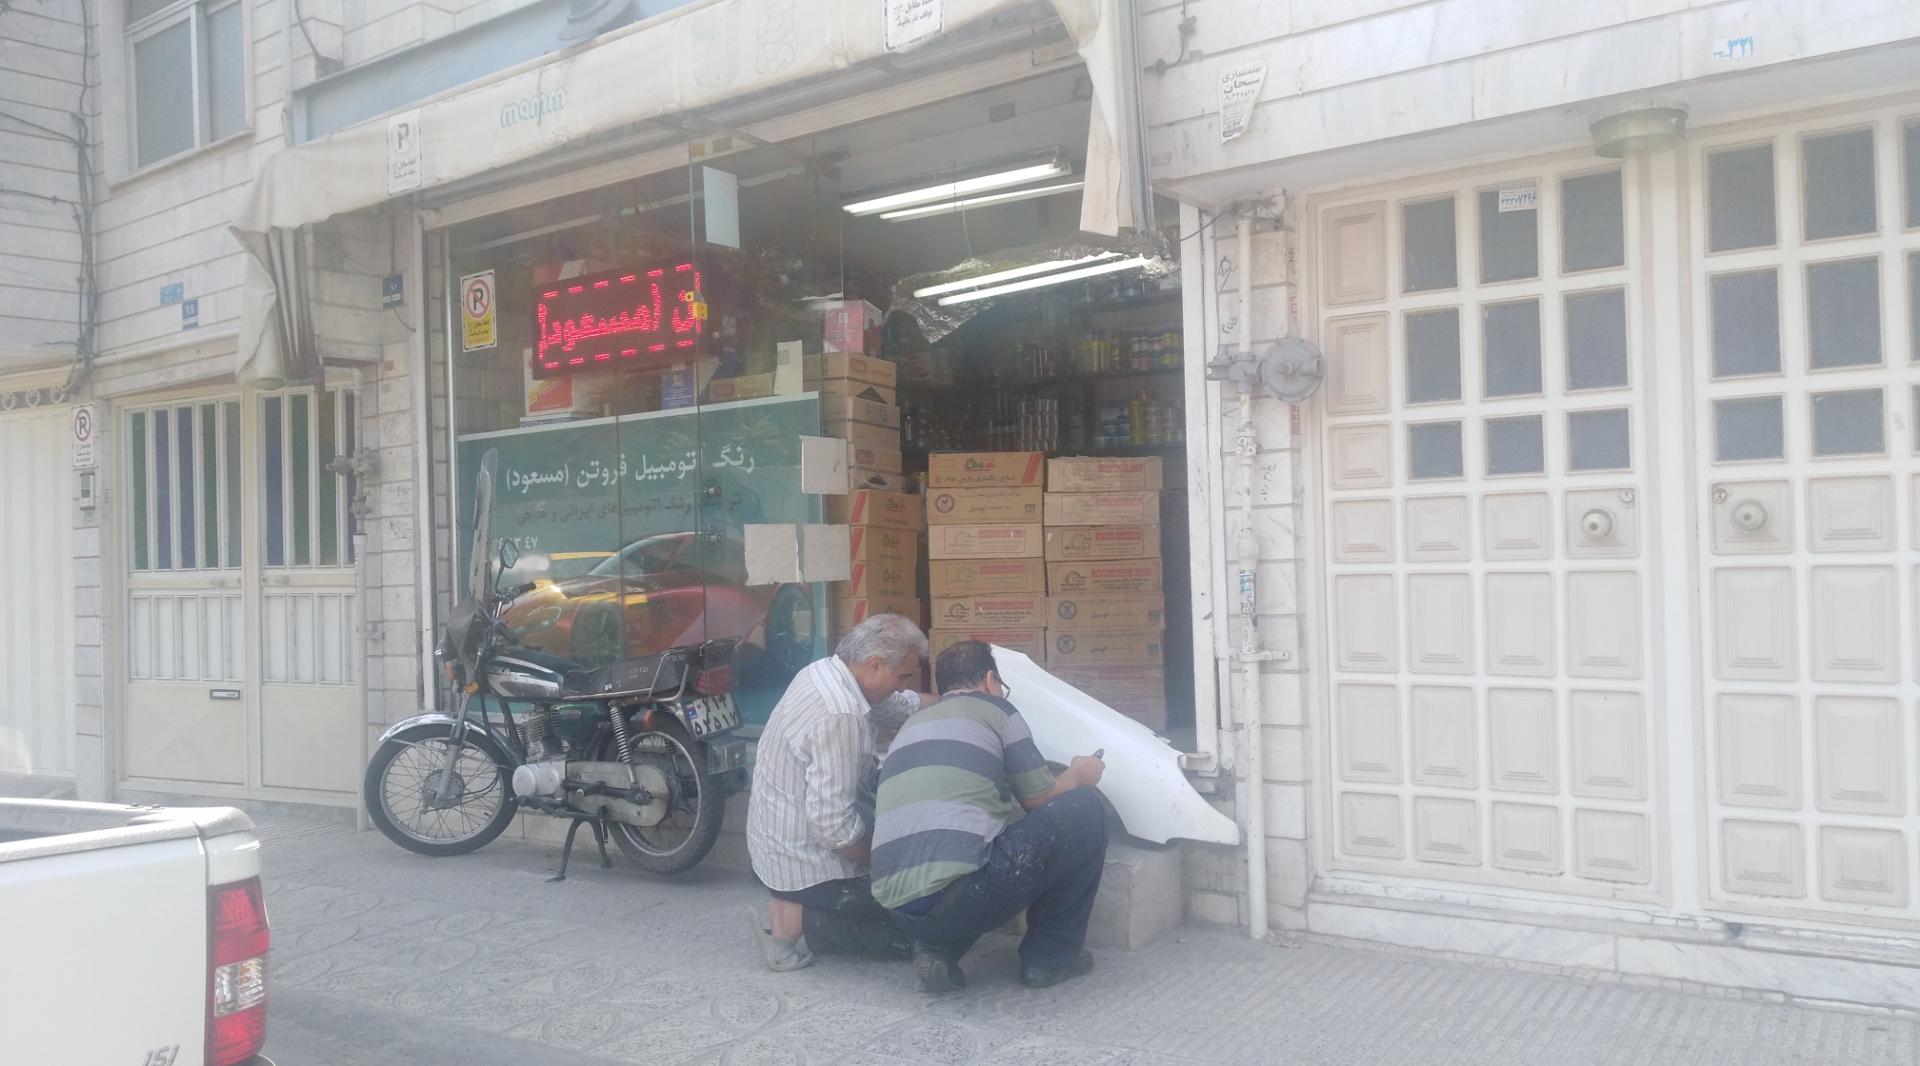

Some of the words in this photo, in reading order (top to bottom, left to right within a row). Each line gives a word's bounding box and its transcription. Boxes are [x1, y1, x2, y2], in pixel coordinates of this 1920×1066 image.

[576, 452, 628, 488] فروتن
[711, 445, 756, 475] رنگ
[506, 462, 569, 494] (مسعود)
